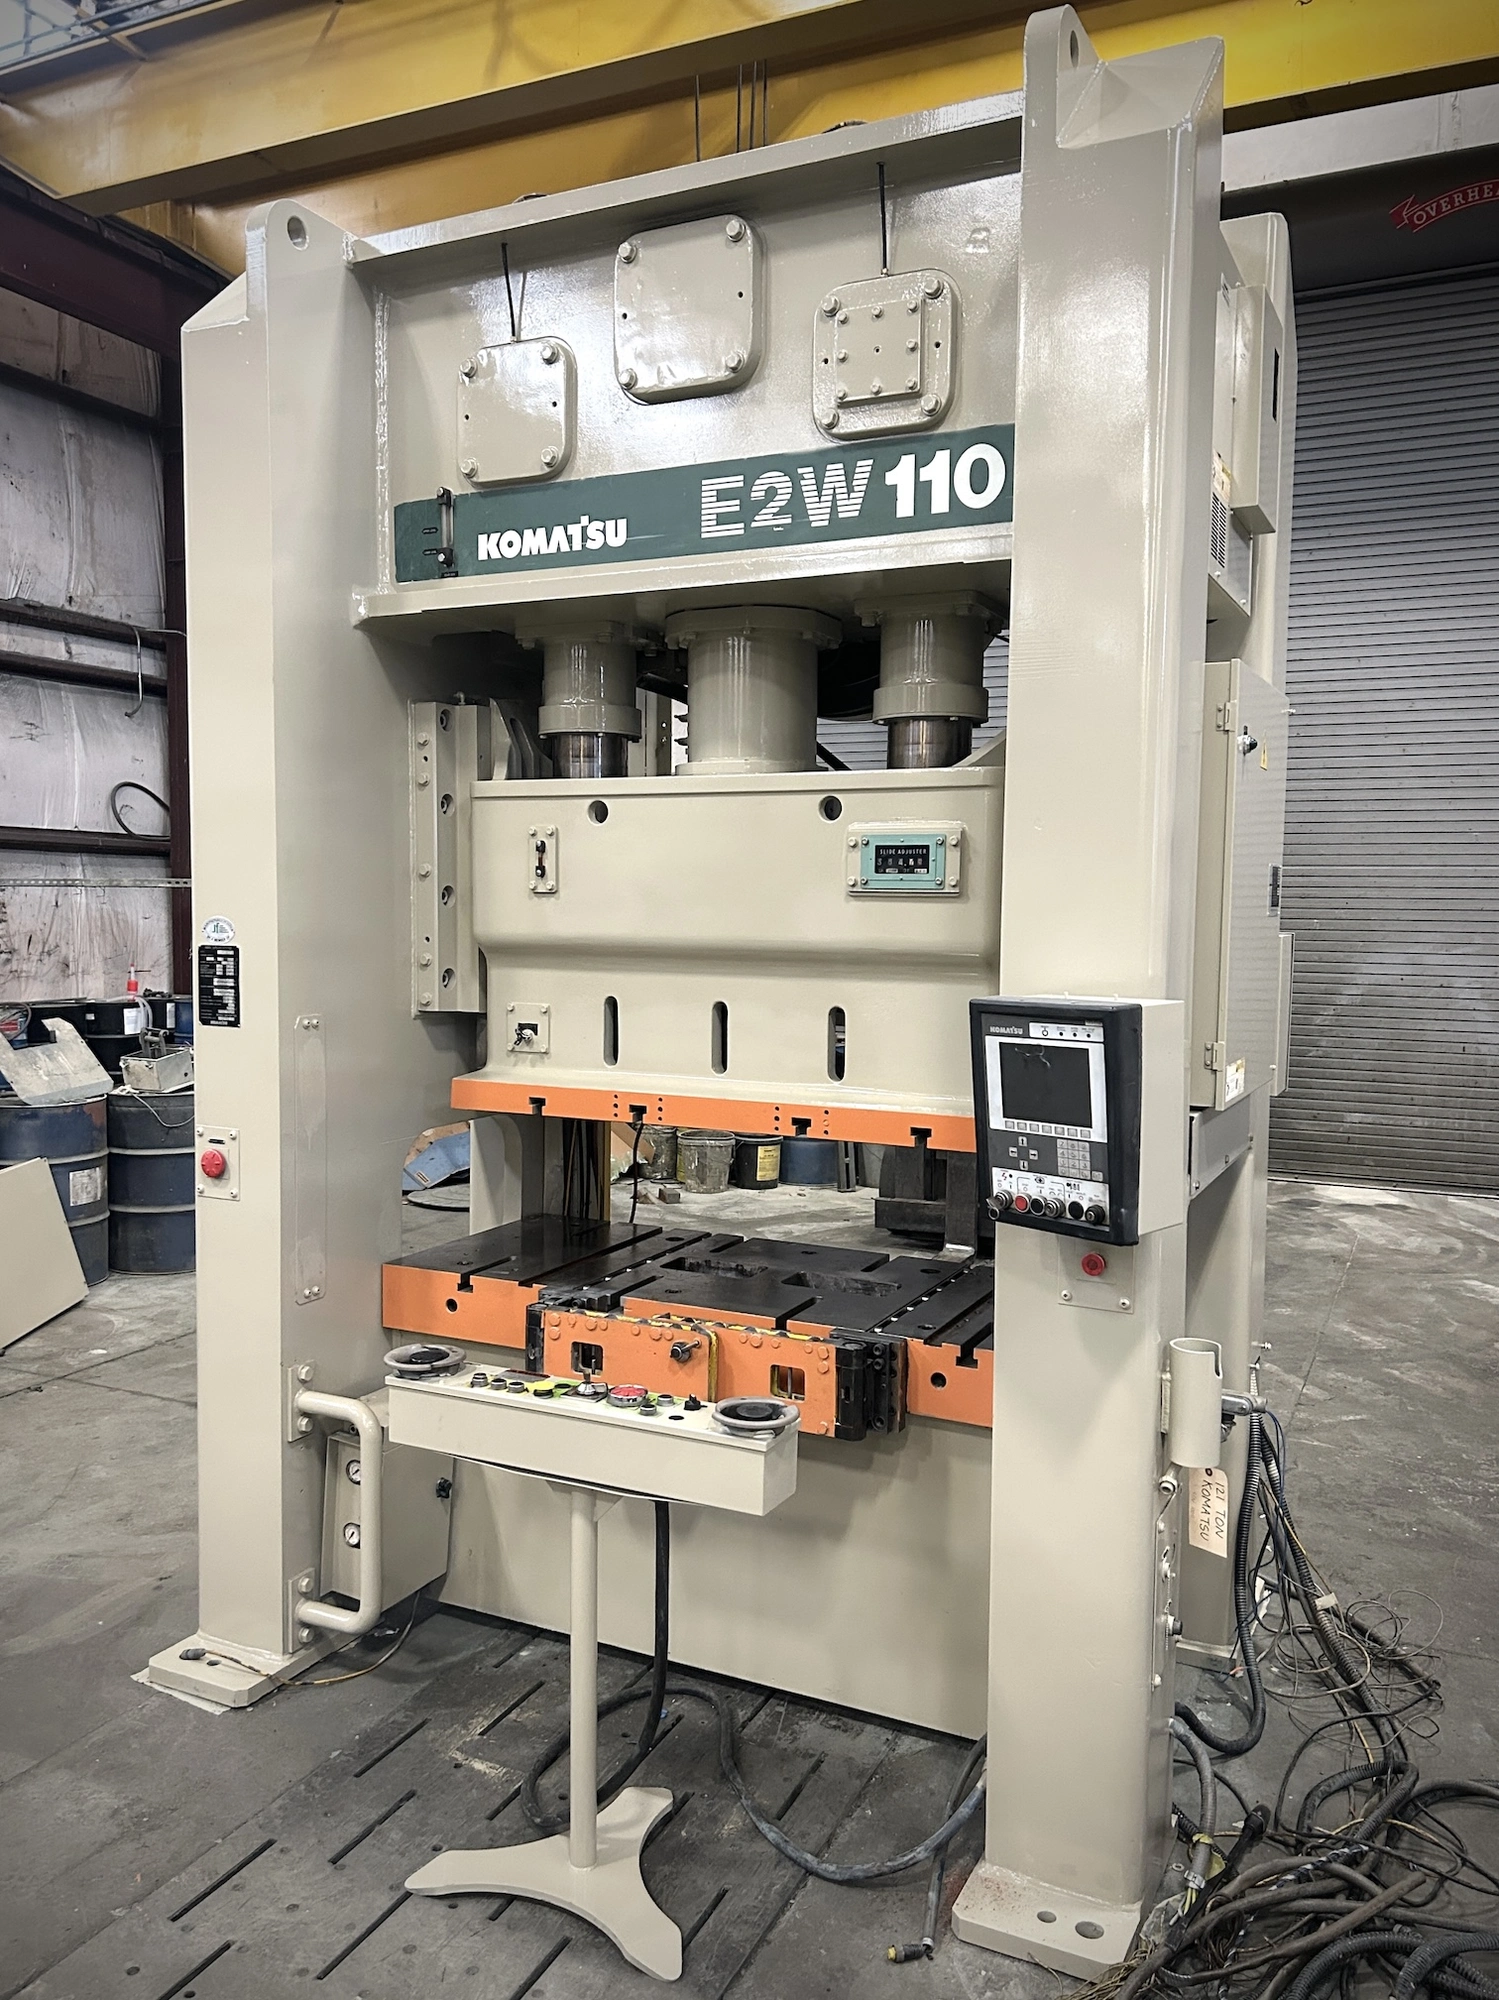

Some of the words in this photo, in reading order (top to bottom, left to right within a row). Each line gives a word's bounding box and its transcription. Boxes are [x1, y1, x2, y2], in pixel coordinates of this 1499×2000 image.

[1413, 184, 1499, 225] OVERHE
[701, 458, 874, 539] E2W
[884, 443, 1006, 519] 110
[477, 515, 627, 561] KOMATSU
[989, 1025, 1023, 1035] KOMATSU
[1199, 1479, 1213, 1542] KOMATSU
[1215, 1481, 1225, 1502] 121
[1214, 1510, 1226, 1540] TON
